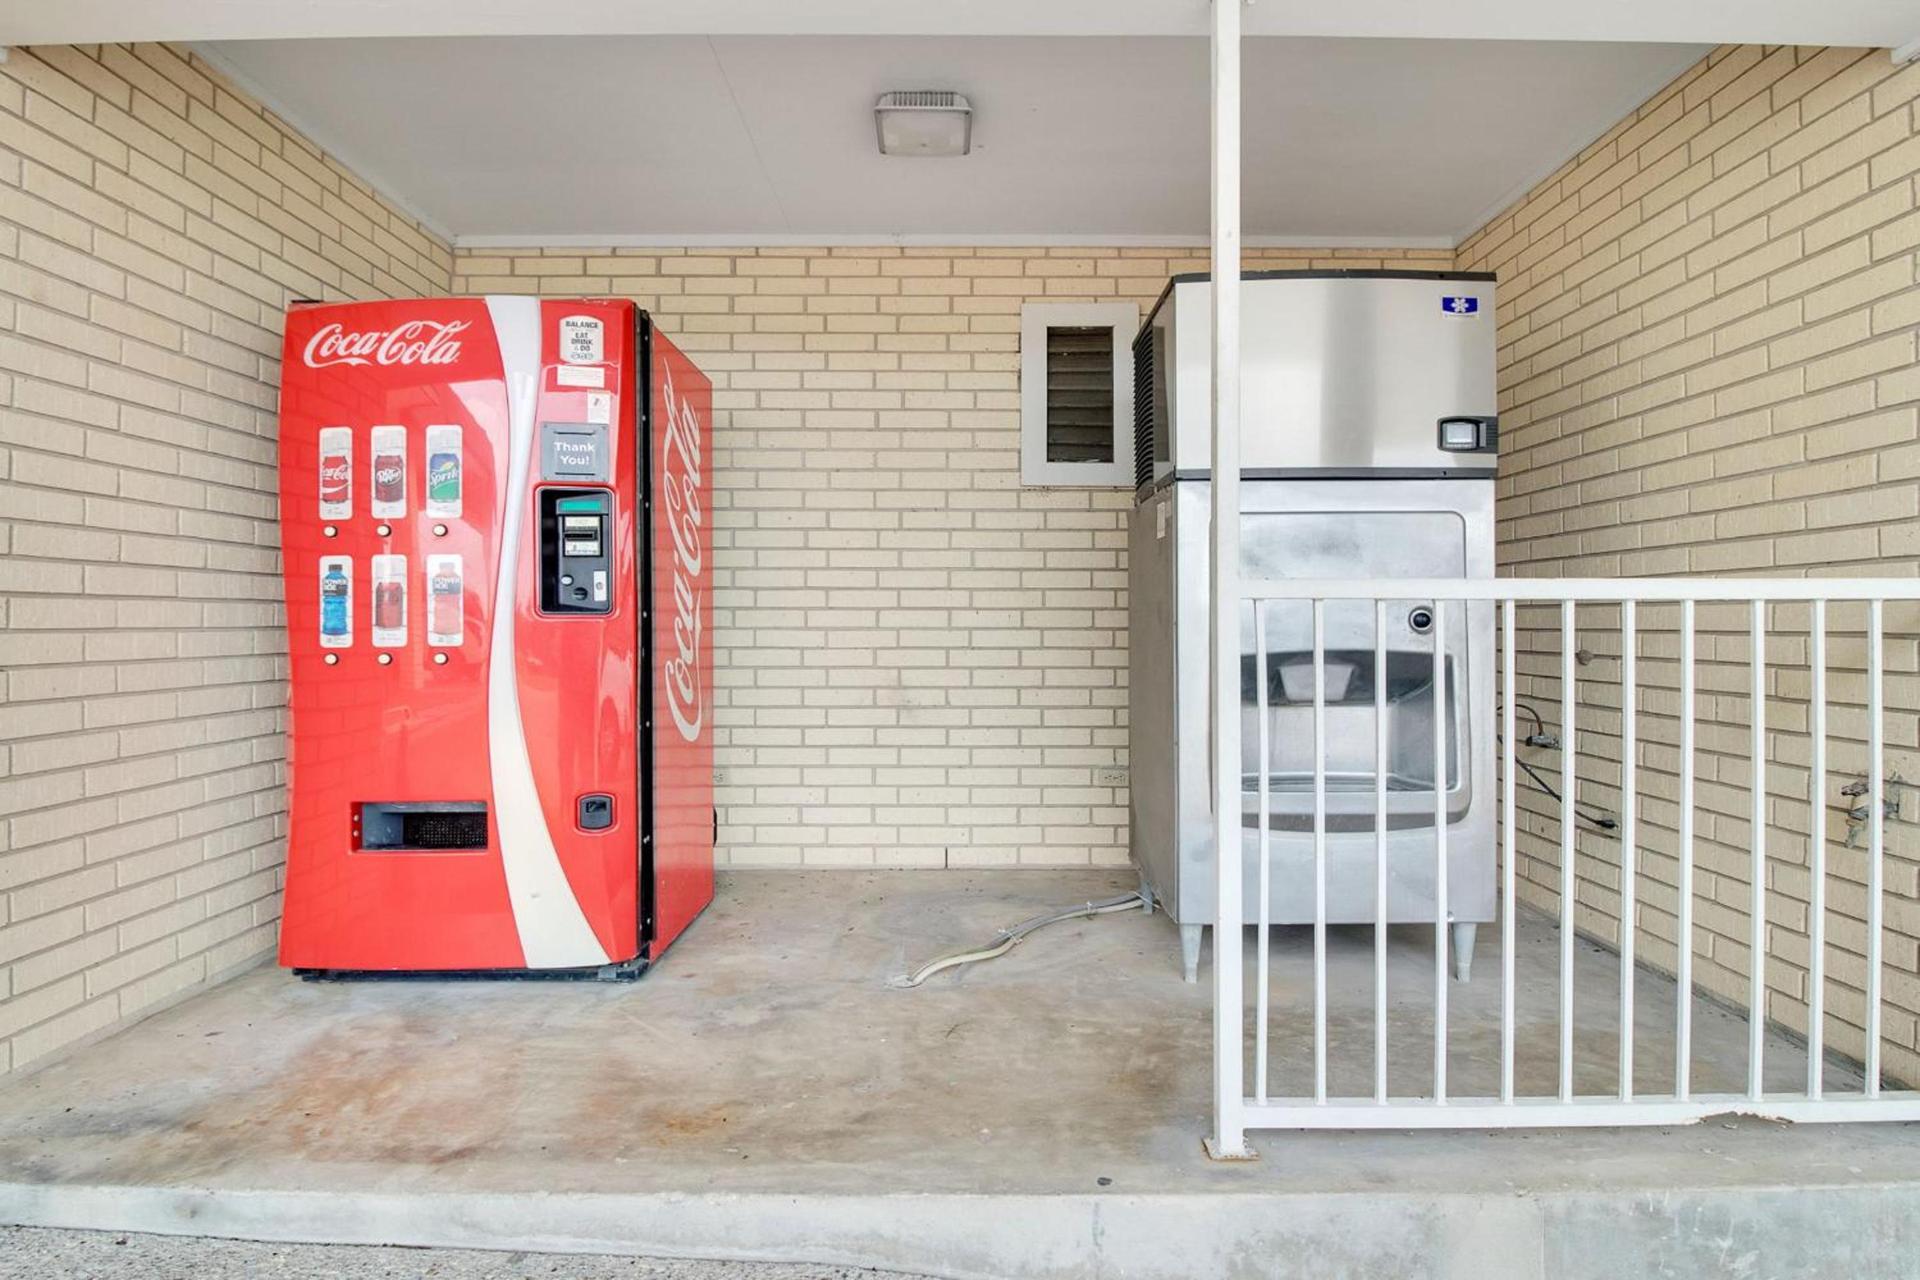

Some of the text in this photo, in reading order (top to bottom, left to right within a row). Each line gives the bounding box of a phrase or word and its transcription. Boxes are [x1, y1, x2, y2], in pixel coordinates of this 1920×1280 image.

[565, 320, 599, 329] BALANCE
[303, 319, 473, 368] Coca-Cola
[553, 441, 596, 452] Thank
[560, 455, 590, 466] You!
[664, 357, 701, 742] Coca-Cola
